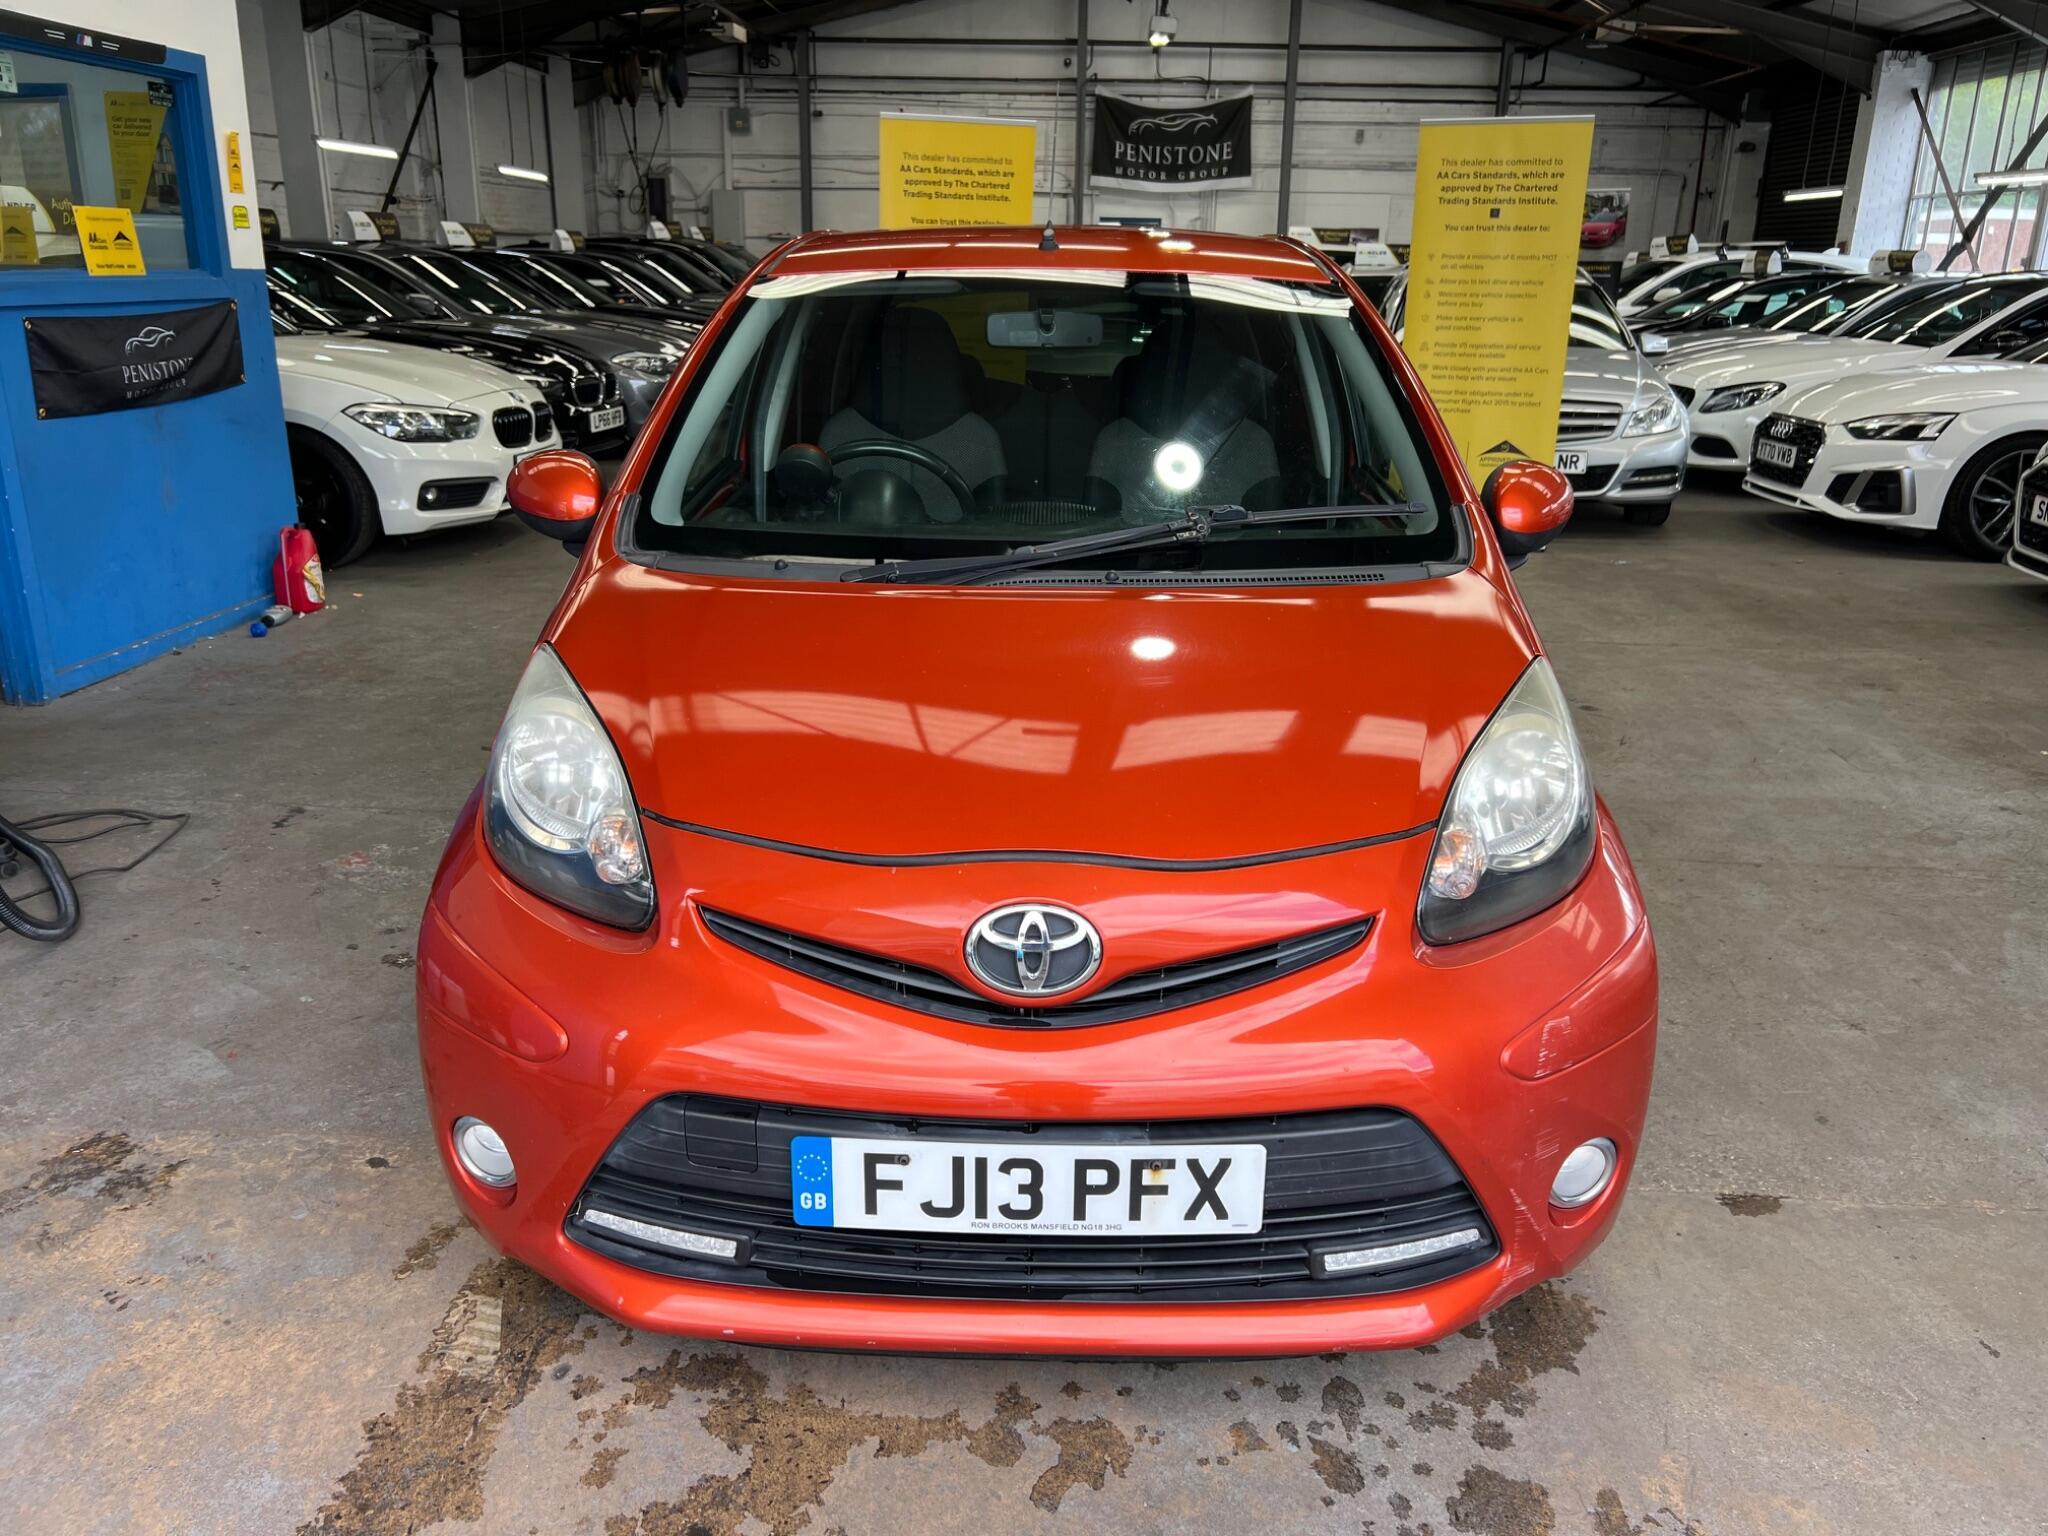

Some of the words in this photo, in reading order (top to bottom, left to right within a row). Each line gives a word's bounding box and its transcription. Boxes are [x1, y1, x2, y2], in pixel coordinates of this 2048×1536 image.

[903, 152, 918, 161] This
[921, 152, 945, 162] dealer
[947, 154, 960, 163] has
[962, 155, 1004, 165] committed
[1005, 157, 1012, 165] to
[1115, 141, 1233, 165] PENISTONE
[1441, 158, 1458, 166] This
[1489, 158, 1503, 166] has
[1506, 158, 1552, 166] committed
[1554, 158, 1564, 166] to
[913, 166, 931, 174] Cars
[933, 166, 976, 176] Standards,
[978, 169, 1000, 177] which
[1115, 166, 1167, 180] MOTOR
[1178, 166, 1229, 180] GROUP
[1437, 171, 1449, 179] AA
[1451, 171, 1470, 180] Cars
[1473, 171, 1520, 180] Standards,
[1522, 171, 1548, 179] which
[904, 178, 942, 188] approved
[944, 180, 953, 188] by
[955, 180, 969, 188] The
[971, 181, 1010, 190] Chartered
[1440, 184, 1481, 193] approved
[1483, 184, 1494, 193] by
[1496, 184, 1512, 192] The
[1514, 184, 1558, 192] Chartered
[904, 190, 932, 200] Trading
[934, 191, 974, 200] Standards
[976, 193, 1012, 202] Institute.
[1439, 197, 1470, 206] Trading
[1472, 197, 1516, 205] Standards
[1519, 197, 1558, 205] Institute.
[1445, 224, 1458, 232] You
[1476, 224, 1494, 232] trust
[1496, 224, 1511, 232] this
[1513, 224, 1538, 232] dealer
[1540, 224, 1550, 232] to:
[863, 1152, 1044, 1220] FJ13
[1073, 1158, 1232, 1221] PFX
[800, 1192, 828, 1210] GB
[992, 1222, 1029, 1230] BROOKS
